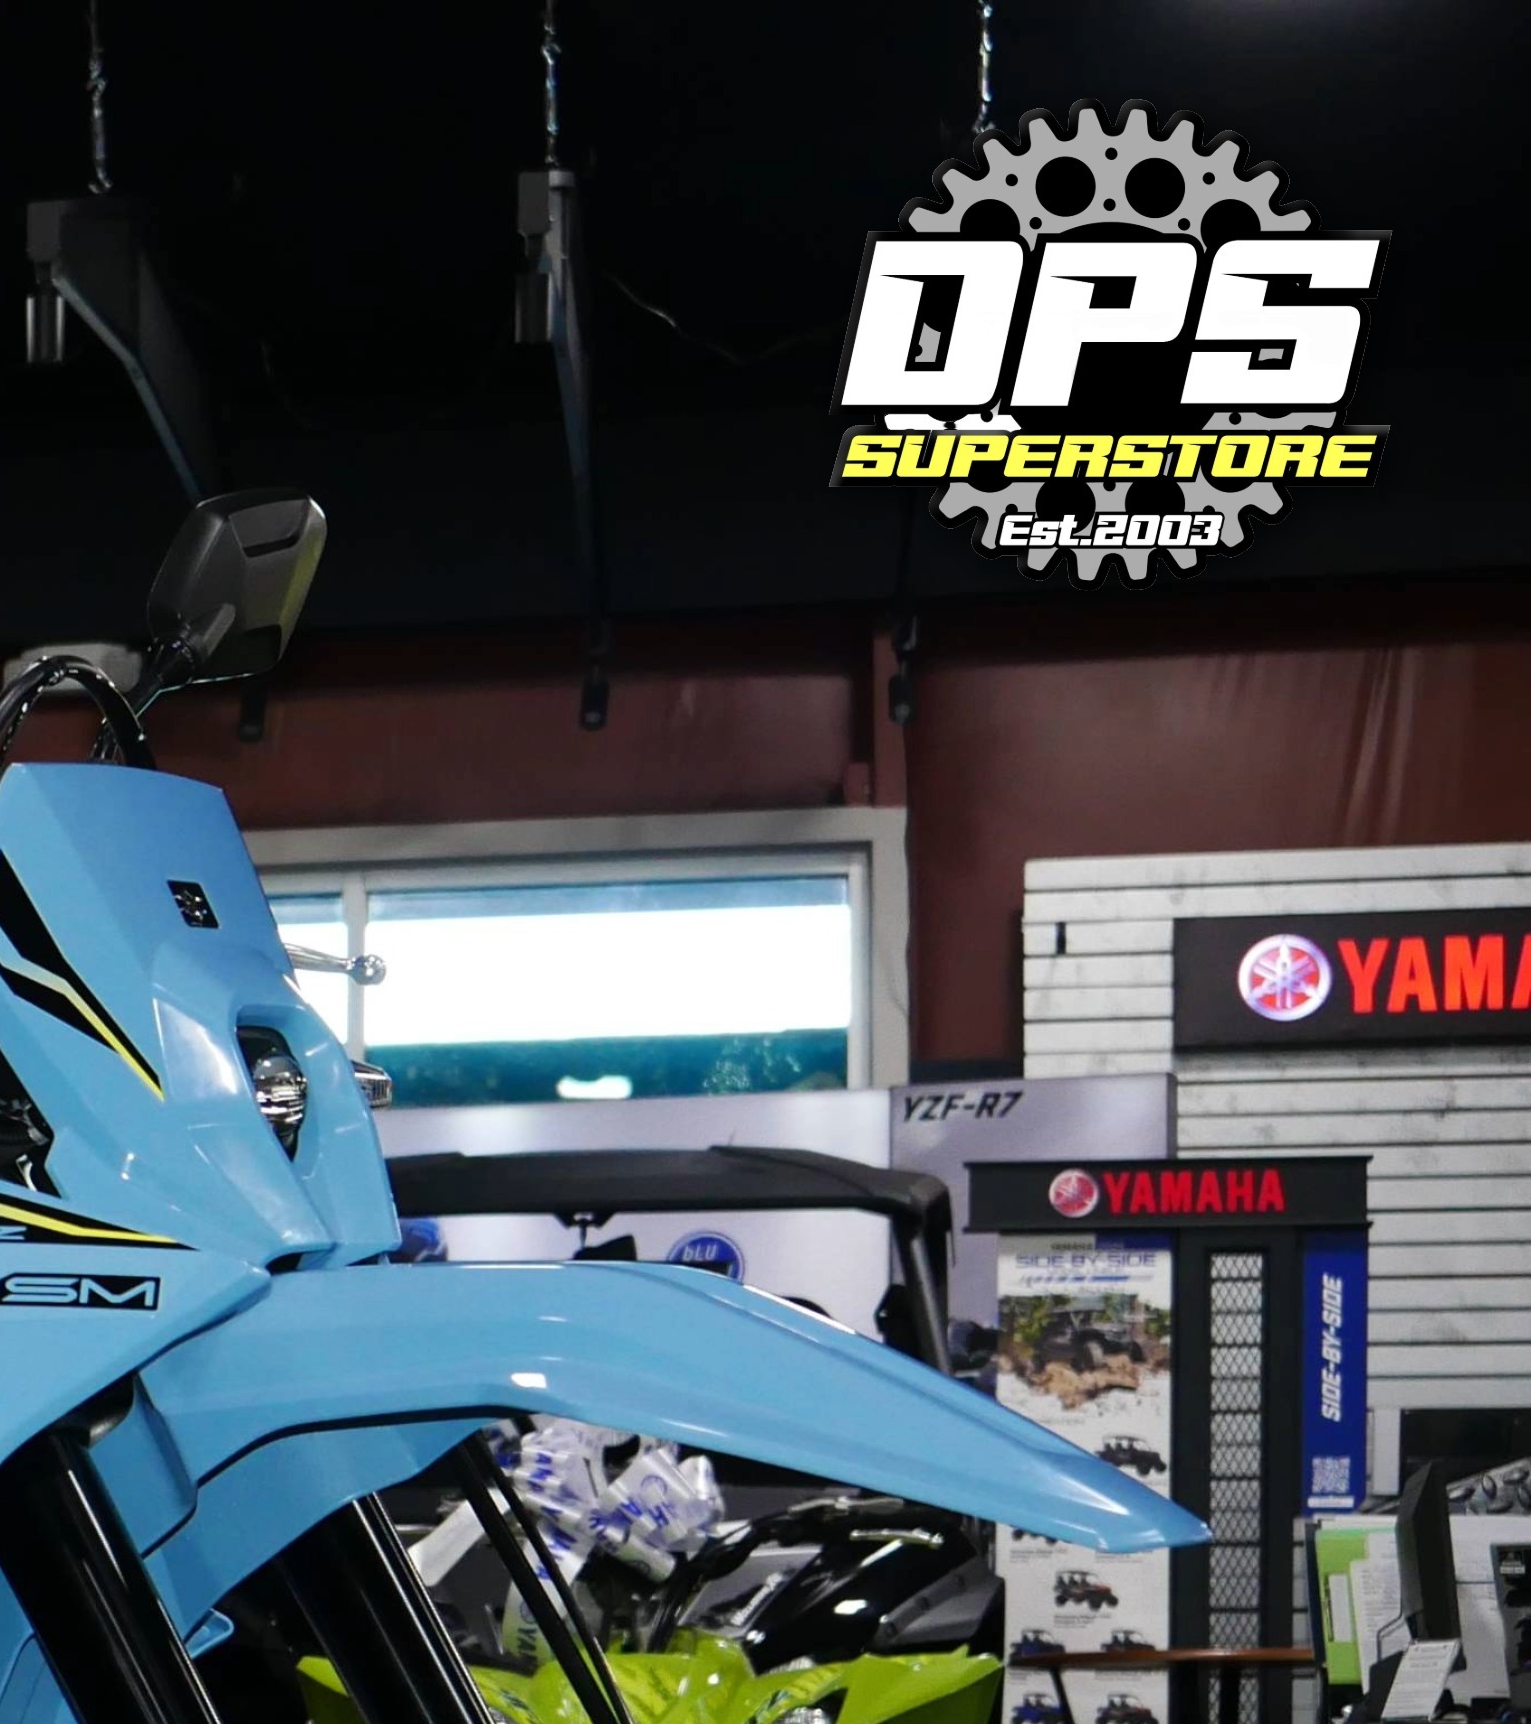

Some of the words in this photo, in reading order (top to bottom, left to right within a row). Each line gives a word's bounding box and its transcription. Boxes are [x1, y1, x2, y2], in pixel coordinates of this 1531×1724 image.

[900, 1090, 1024, 1123] YZF-R7
[1104, 1168, 1287, 1214] YAMAHA
[1320, 1273, 1344, 1422] SIDE-BY-SIDE
